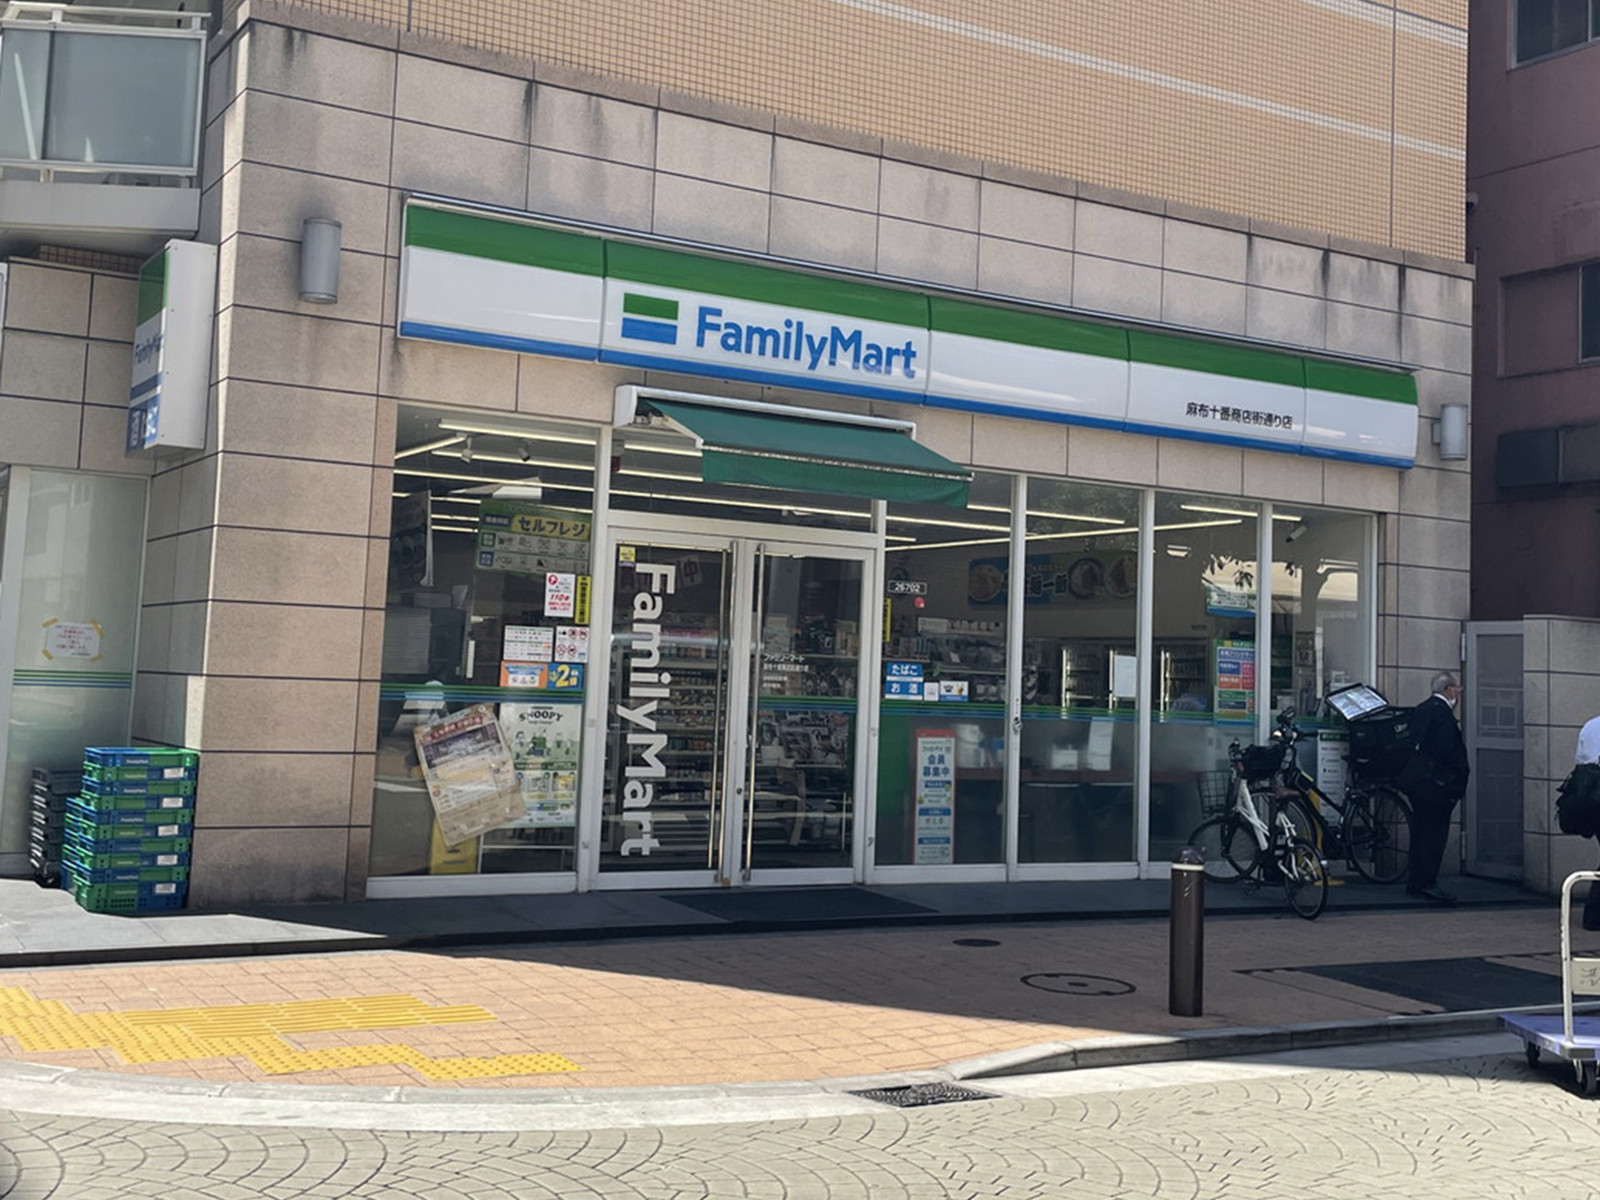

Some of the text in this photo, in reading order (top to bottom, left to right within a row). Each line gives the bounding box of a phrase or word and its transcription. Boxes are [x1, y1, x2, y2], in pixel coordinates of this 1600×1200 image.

[696, 306, 917, 378] FamilyMart
[1186, 402, 1293, 430] 麻布十番商店街通り店
[518, 516, 586, 538] セルフレジ
[891, 664, 919, 675] たばこ
[519, 710, 564, 722] SNOOPY
[616, 562, 677, 856] FamilyMart
